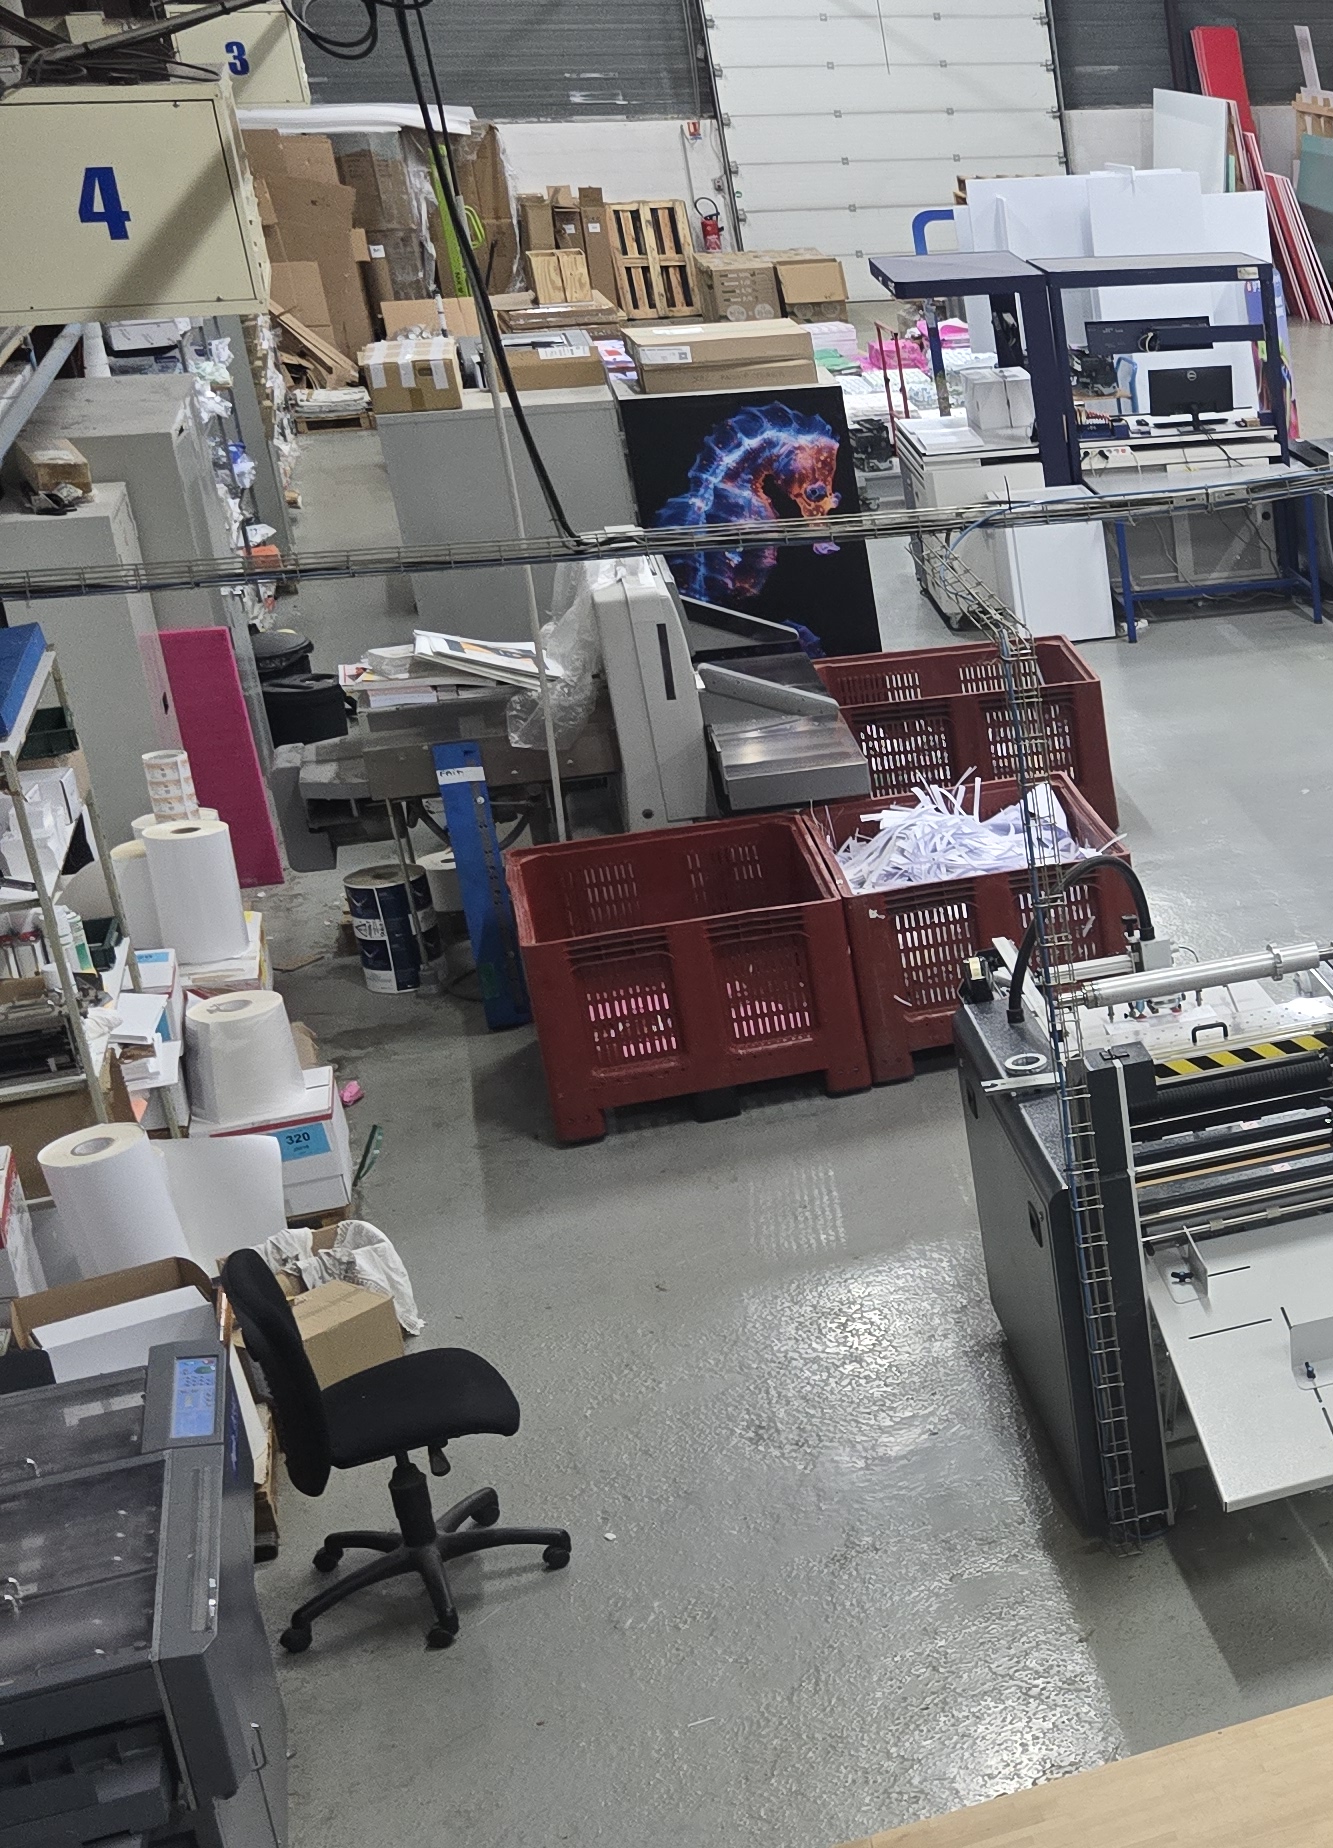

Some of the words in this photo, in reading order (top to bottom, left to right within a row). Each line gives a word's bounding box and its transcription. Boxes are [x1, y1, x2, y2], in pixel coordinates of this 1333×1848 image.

[225, 41, 250, 76] 3
[78, 166, 131, 240] 4
[285, 1131, 311, 1145] 320
